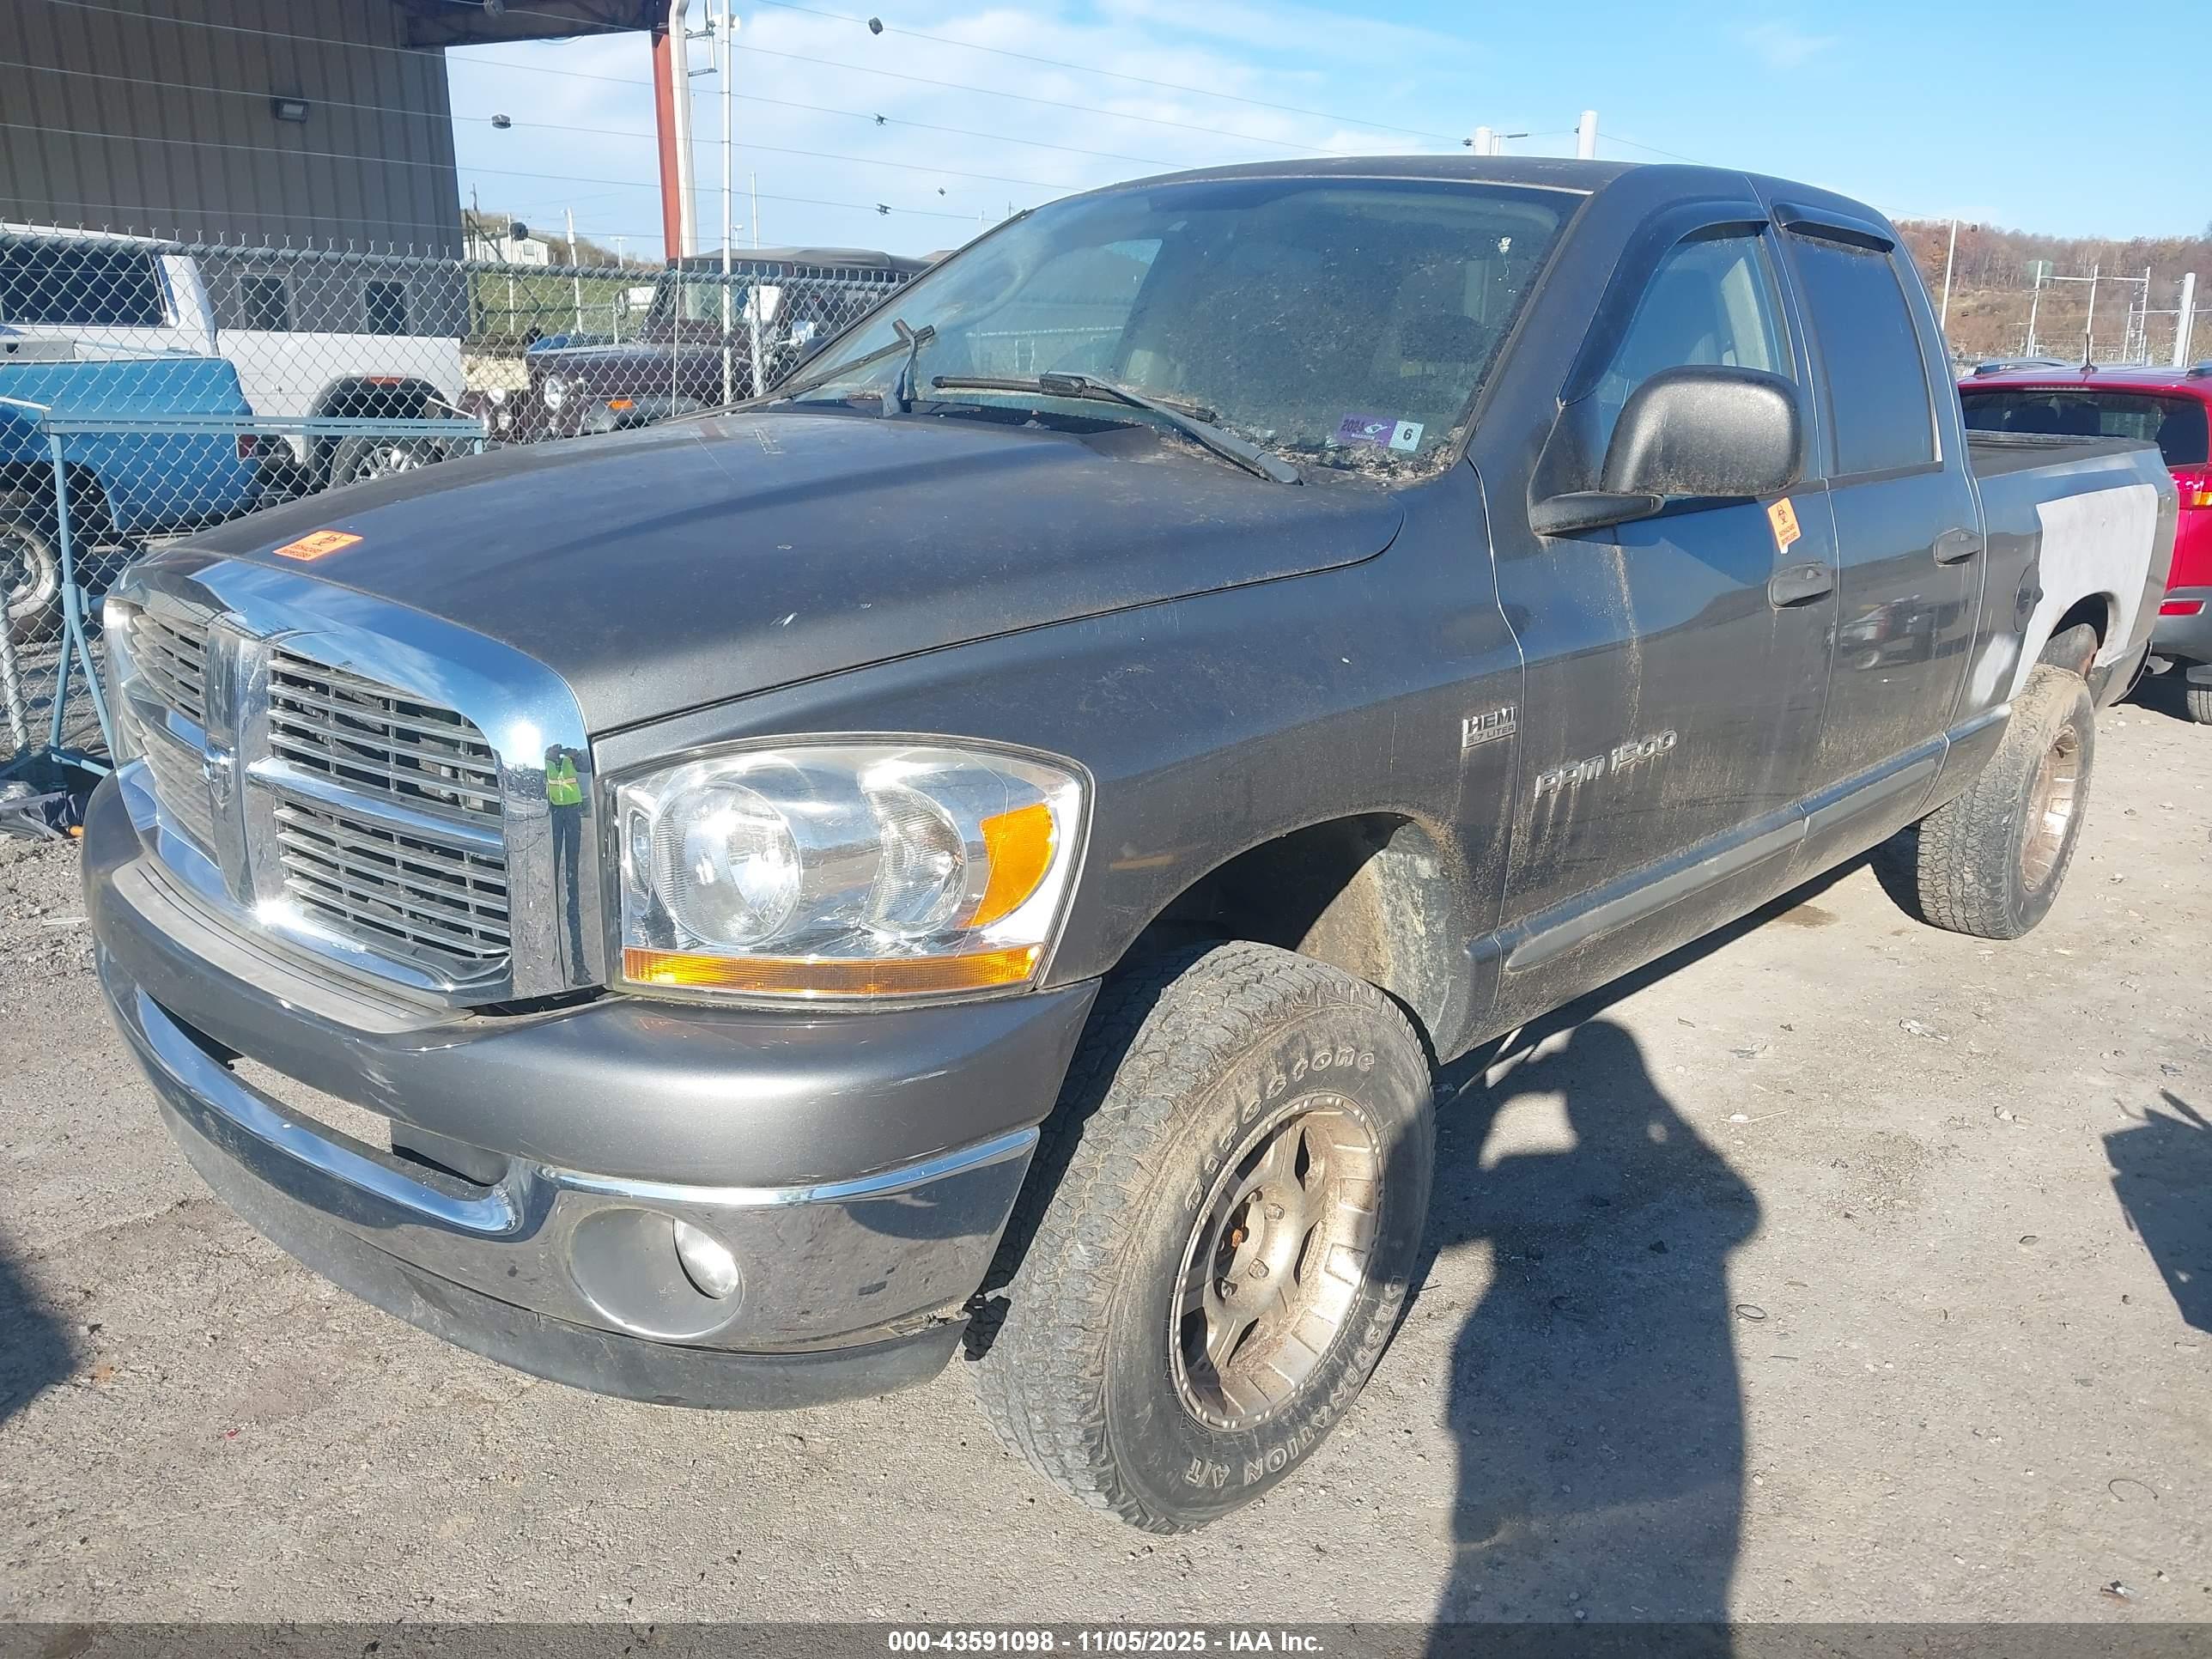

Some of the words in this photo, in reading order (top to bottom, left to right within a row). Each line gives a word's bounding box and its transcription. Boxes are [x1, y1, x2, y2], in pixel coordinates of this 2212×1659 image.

[1403, 428, 1413, 441] 6
[1462, 706, 1517, 738] HEMI
[1468, 732, 1484, 744] 5.7
[1486, 724, 1514, 738] LITER
[1611, 729, 1678, 773] 1500
[1185, 1045, 1375, 1212] Firestone
[1182, 1456, 1231, 1489] A/T
